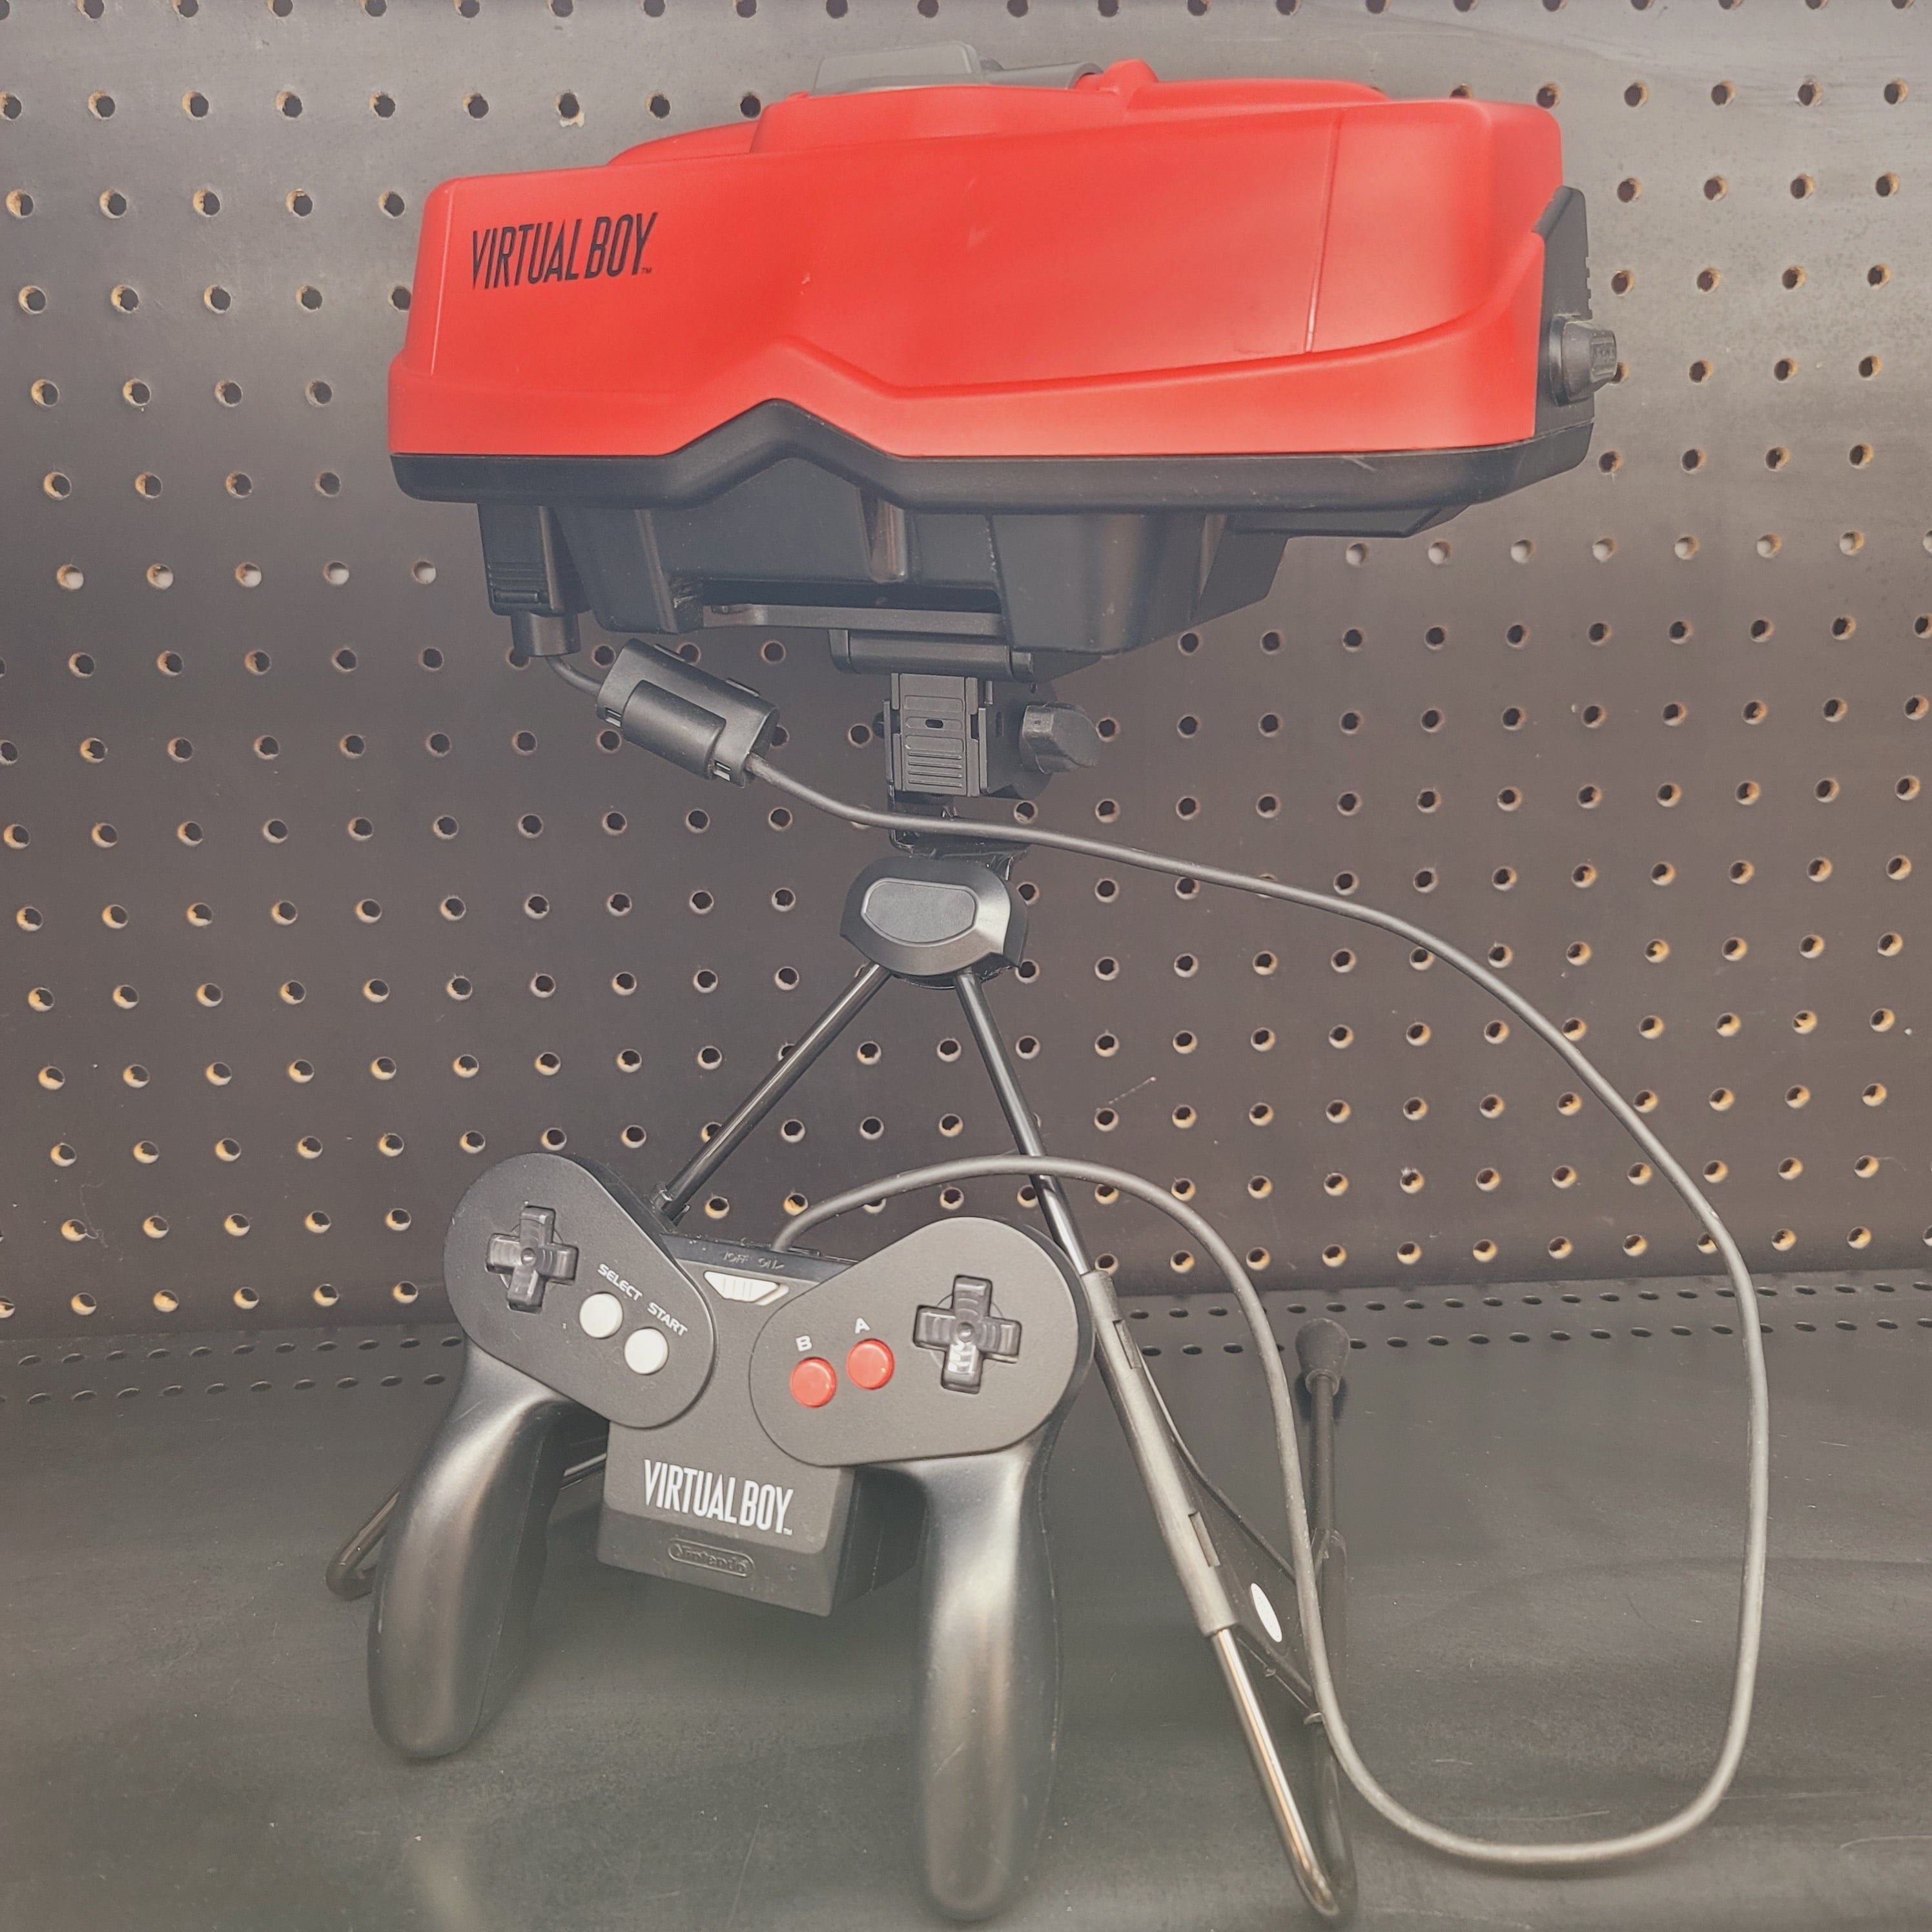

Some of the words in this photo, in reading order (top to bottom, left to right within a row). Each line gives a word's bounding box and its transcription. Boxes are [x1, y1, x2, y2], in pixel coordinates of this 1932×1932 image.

[473, 218, 582, 289] VIRTUAL
[584, 212, 657, 278] BOY
[598, 1264, 642, 1301] SELECT
[647, 1302, 688, 1336] START
[854, 1318, 870, 1334] A
[796, 1335, 812, 1351] B
[644, 1459, 737, 1524] VIRTUAL
[739, 1479, 794, 1534] BOY
[673, 1543, 749, 1572] Nintendo
